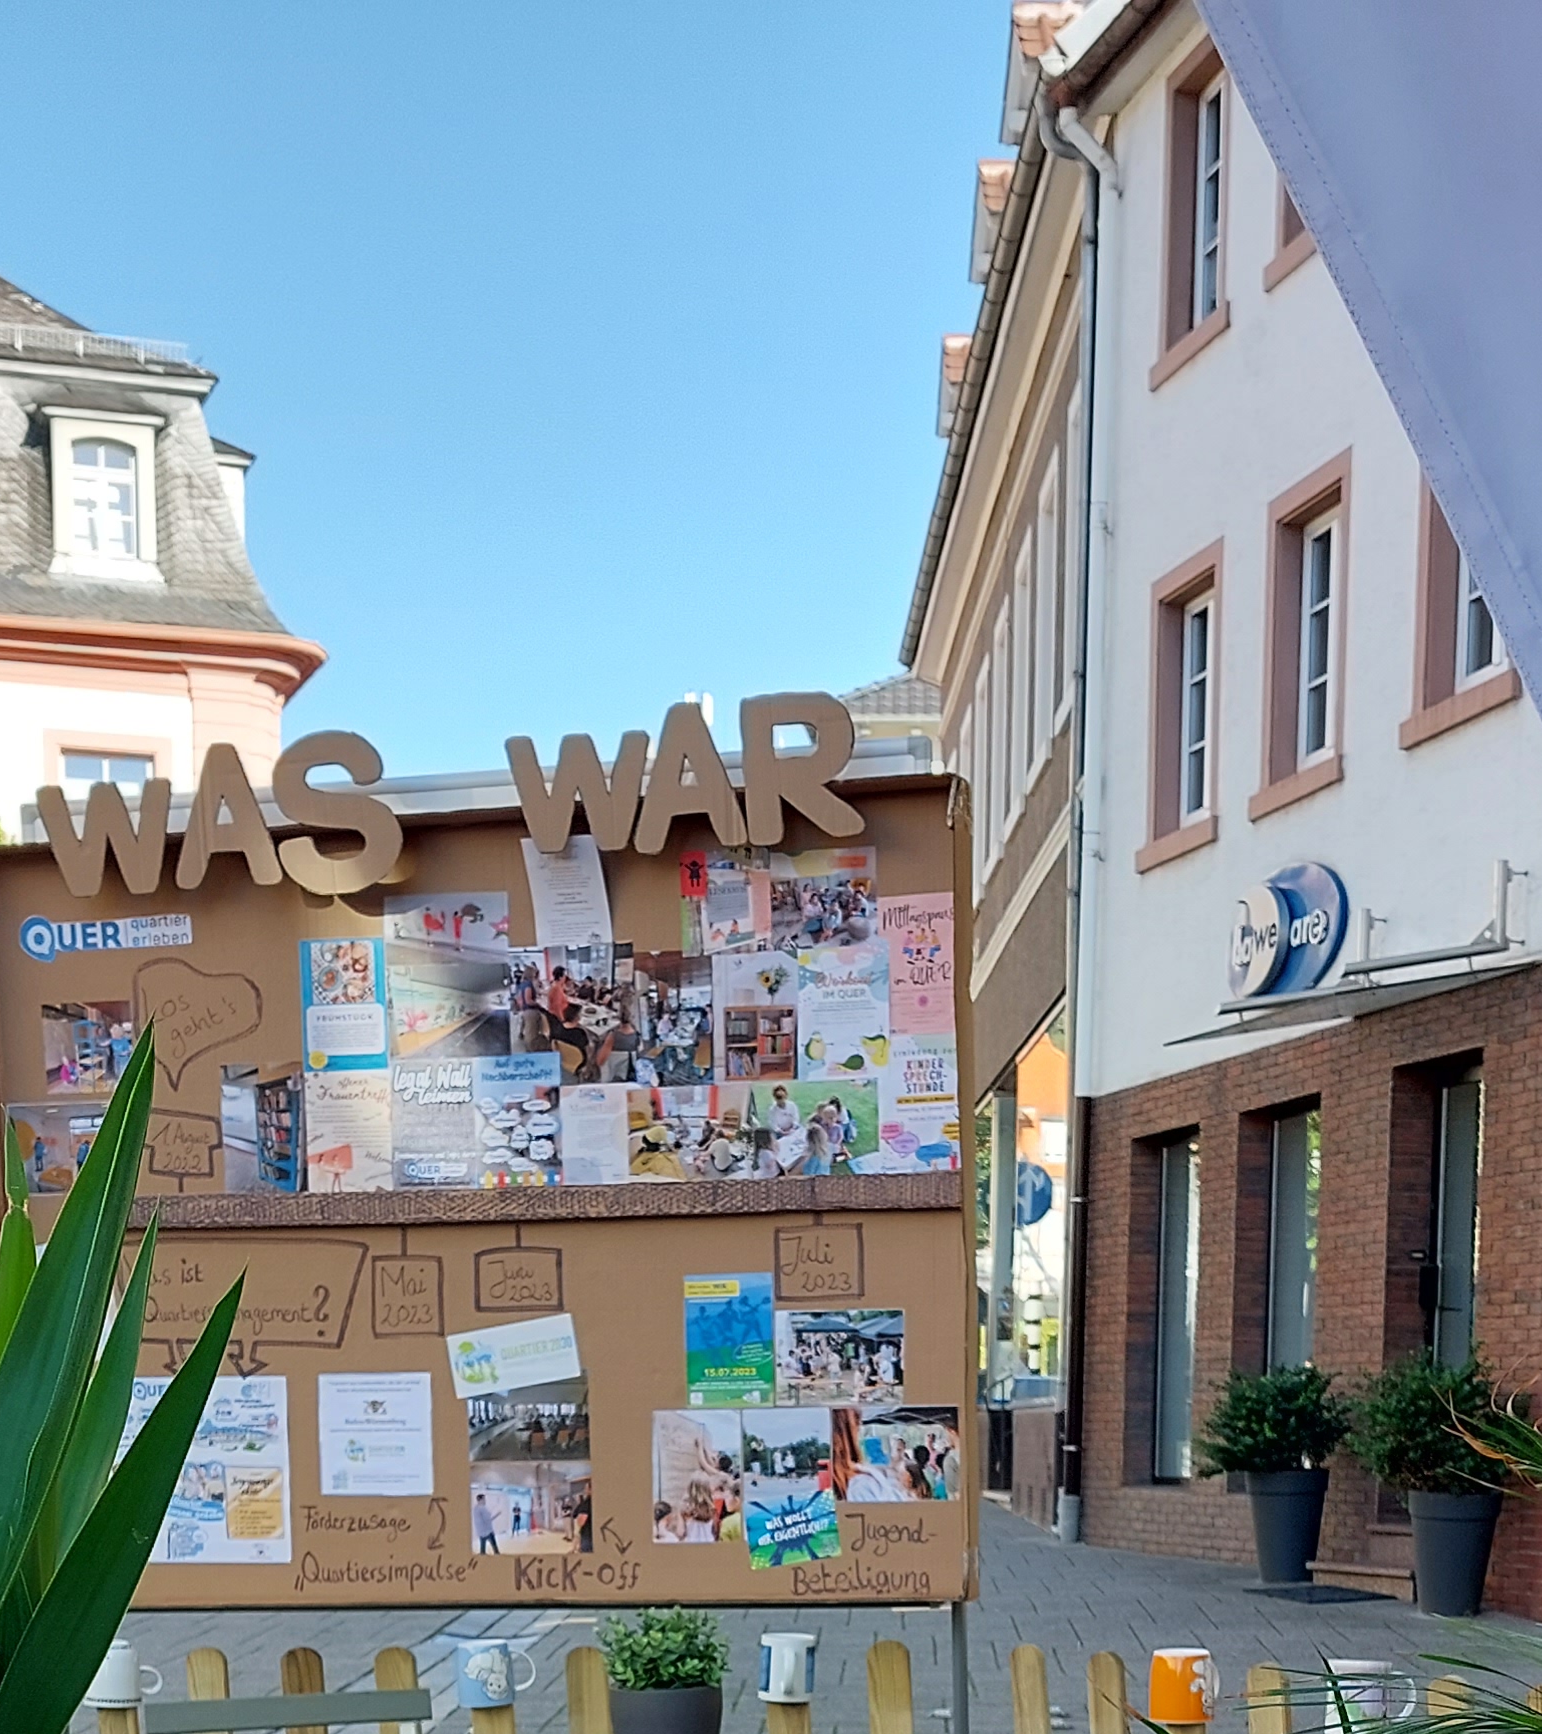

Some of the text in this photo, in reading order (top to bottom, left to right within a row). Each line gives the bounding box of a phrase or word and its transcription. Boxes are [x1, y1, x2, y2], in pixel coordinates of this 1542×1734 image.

[36, 691, 866, 898] WAS WAR
[130, 916, 188, 931] quartier
[22, 916, 123, 960] QUER
[132, 933, 189, 947] erleben
[141, 986, 191, 1024] Los
[839, 988, 867, 1000] QUER
[437, 1063, 472, 1090] Wall
[781, 1235, 835, 1277] Juli
[381, 1265, 428, 1298] Mai
[510, 1282, 554, 1303] 2023
[801, 1271, 852, 1293] 2023
[381, 1303, 434, 1328] 2023
[704, 1367, 757, 1377] 15.07.2023
[299, 1505, 411, 1543] Förderzusage
[790, 1558, 931, 1597] Beteiligung
